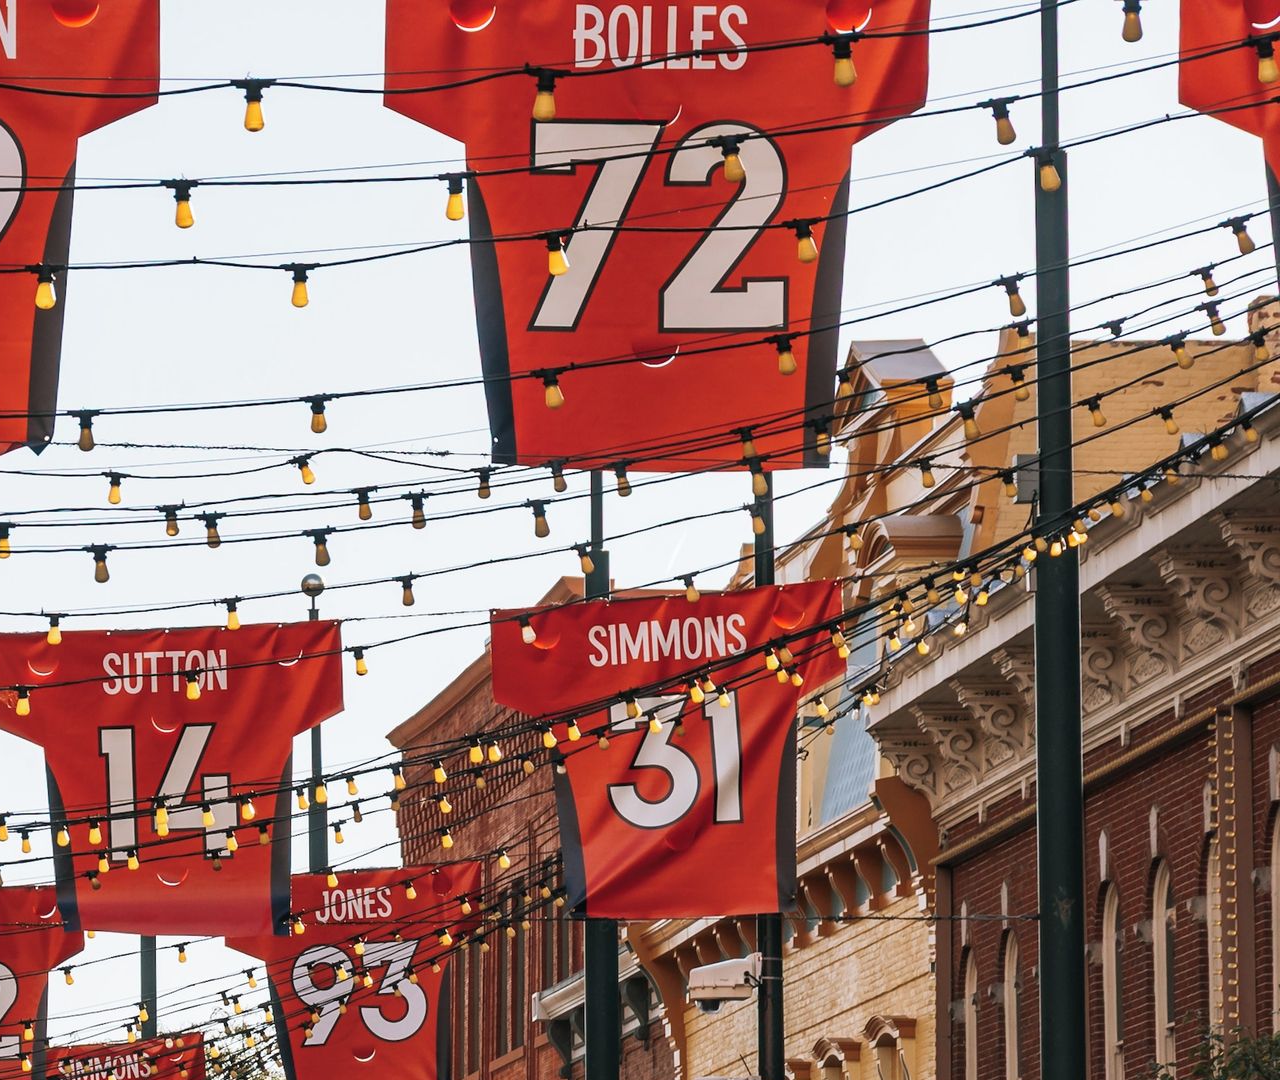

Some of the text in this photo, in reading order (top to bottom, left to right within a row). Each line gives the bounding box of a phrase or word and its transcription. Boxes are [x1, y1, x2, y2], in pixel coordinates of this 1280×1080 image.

[572, 3, 749, 71] BOLLES
[526, 119, 789, 333] 72
[102, 648, 228, 695] SUTTON
[589, 613, 748, 668] SIMMONS
[97, 721, 239, 864] 14
[607, 688, 744, 829] 31
[315, 885, 393, 924] JONES
[291, 939, 428, 1048] 93
